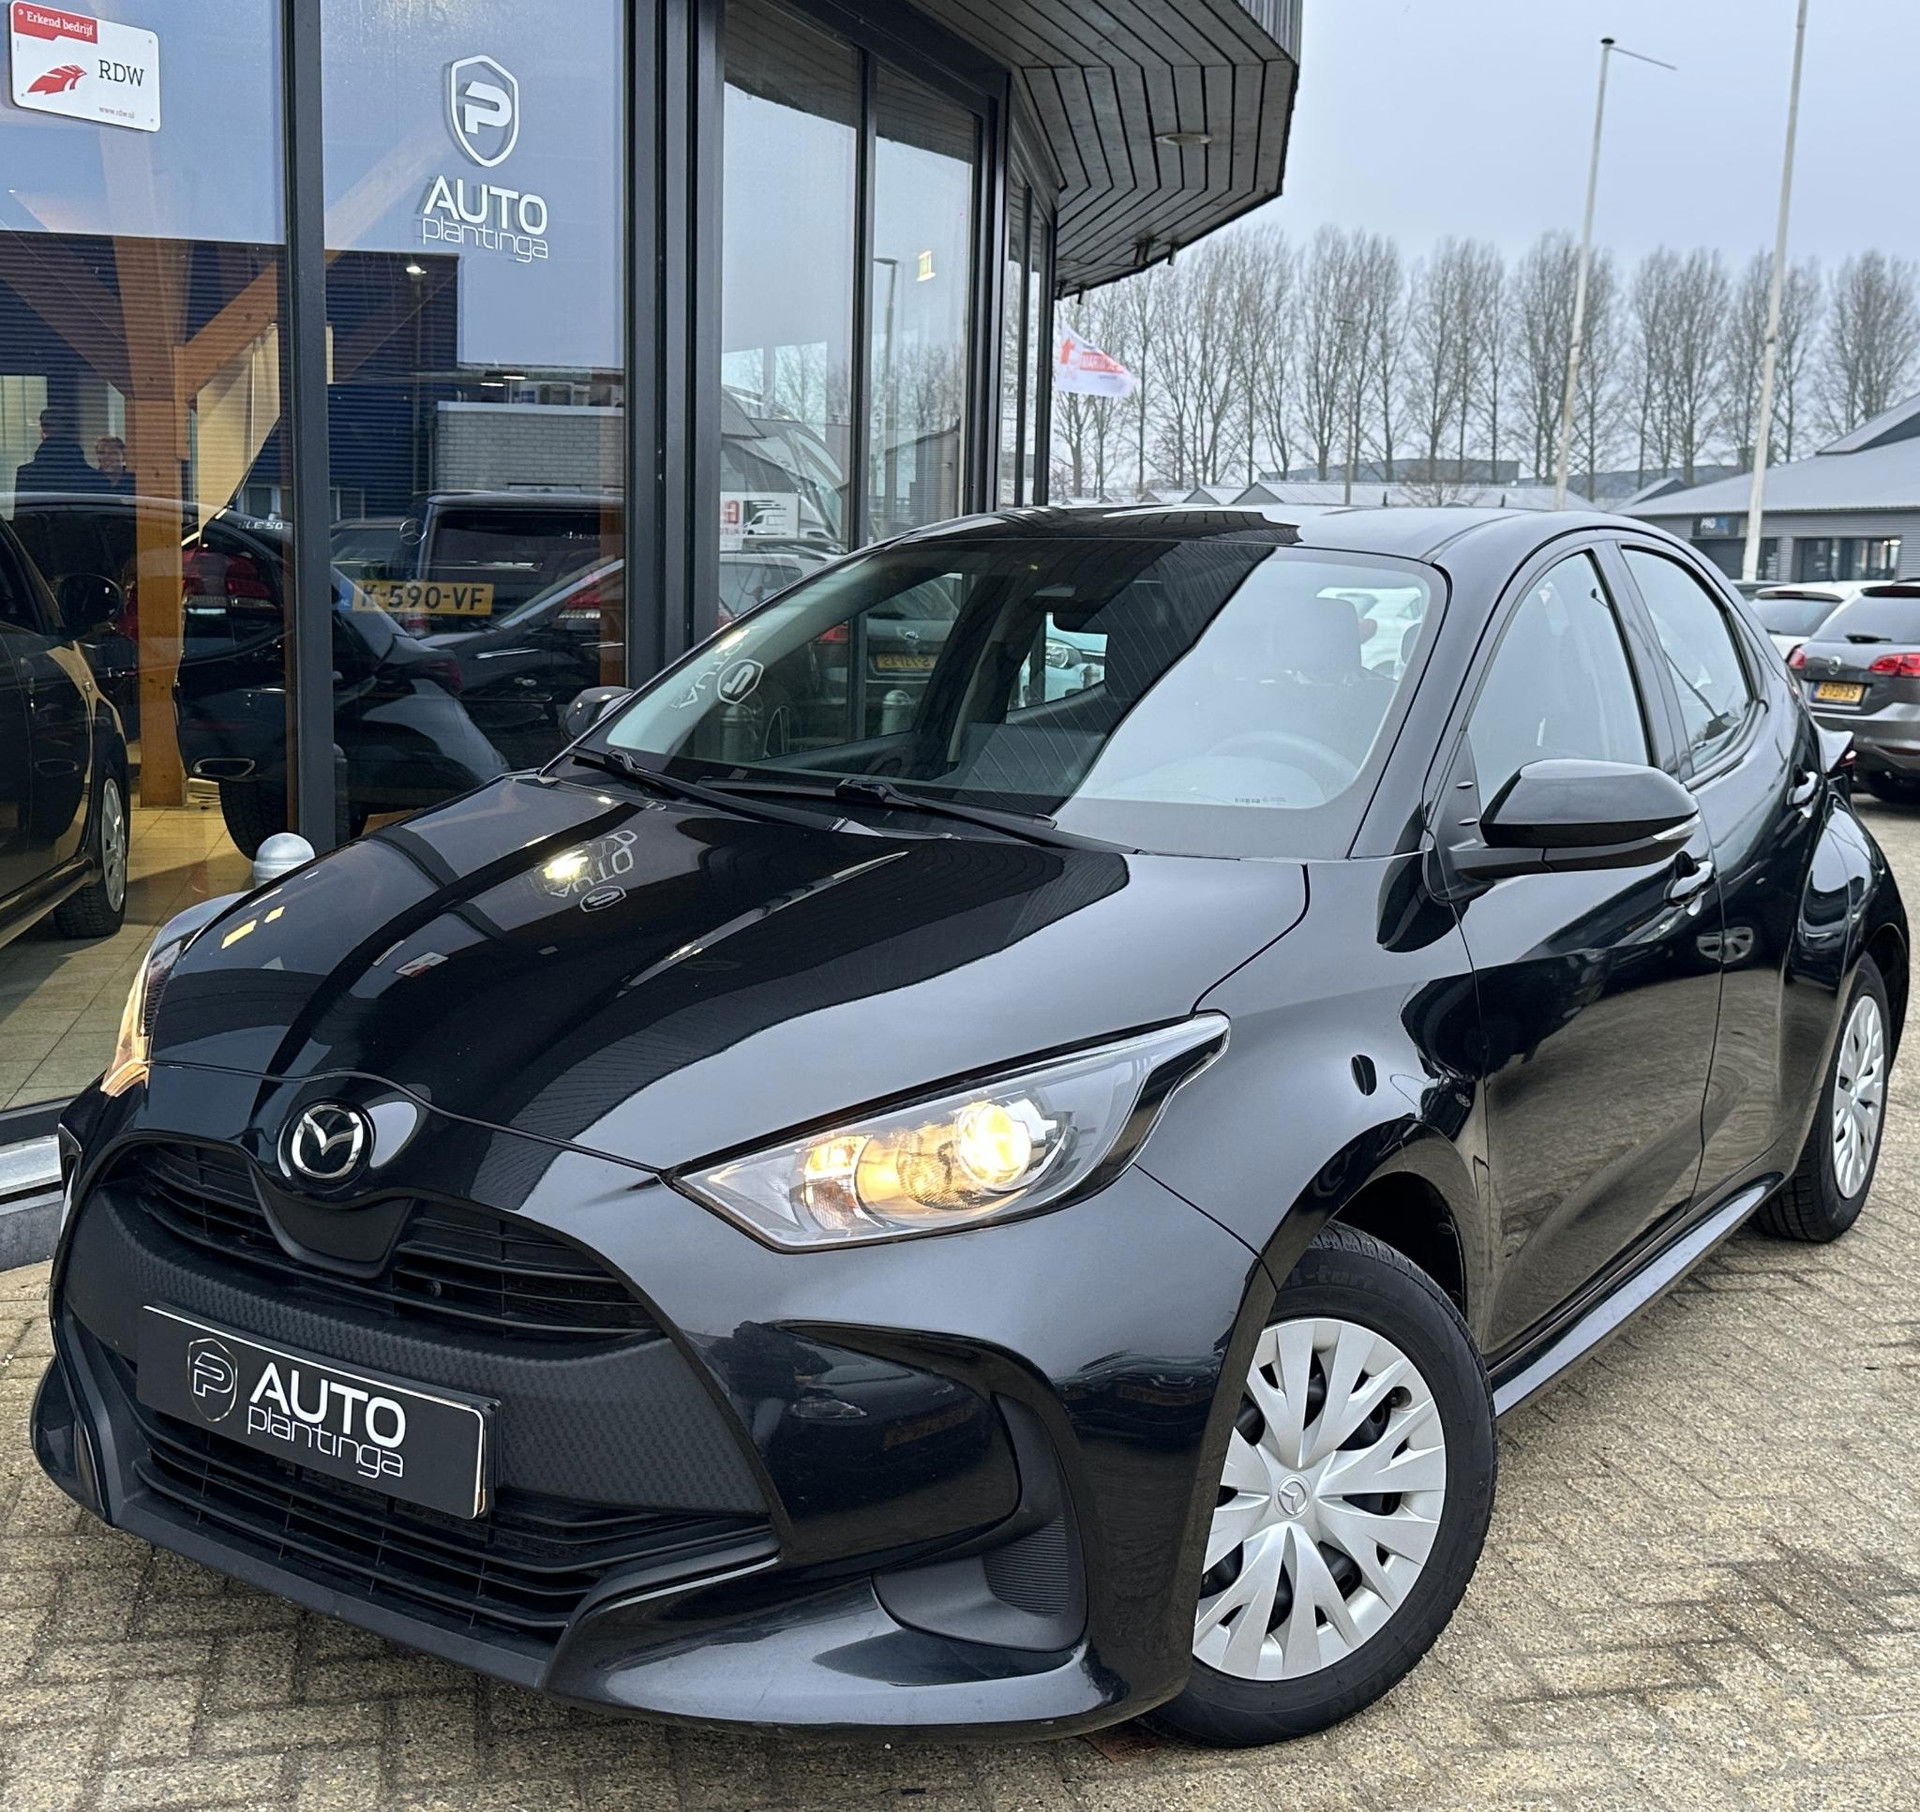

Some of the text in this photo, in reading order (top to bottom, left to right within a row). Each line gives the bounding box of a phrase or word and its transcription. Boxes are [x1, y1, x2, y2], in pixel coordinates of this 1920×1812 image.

[26, 11, 94, 37] Erkend bedrijf
[98, 59, 145, 87] RDW
[423, 175, 548, 235] AUTO
[422, 215, 549, 264] plantinga
[249, 1361, 407, 1449] AUTO
[247, 1403, 404, 1479] plantinga
